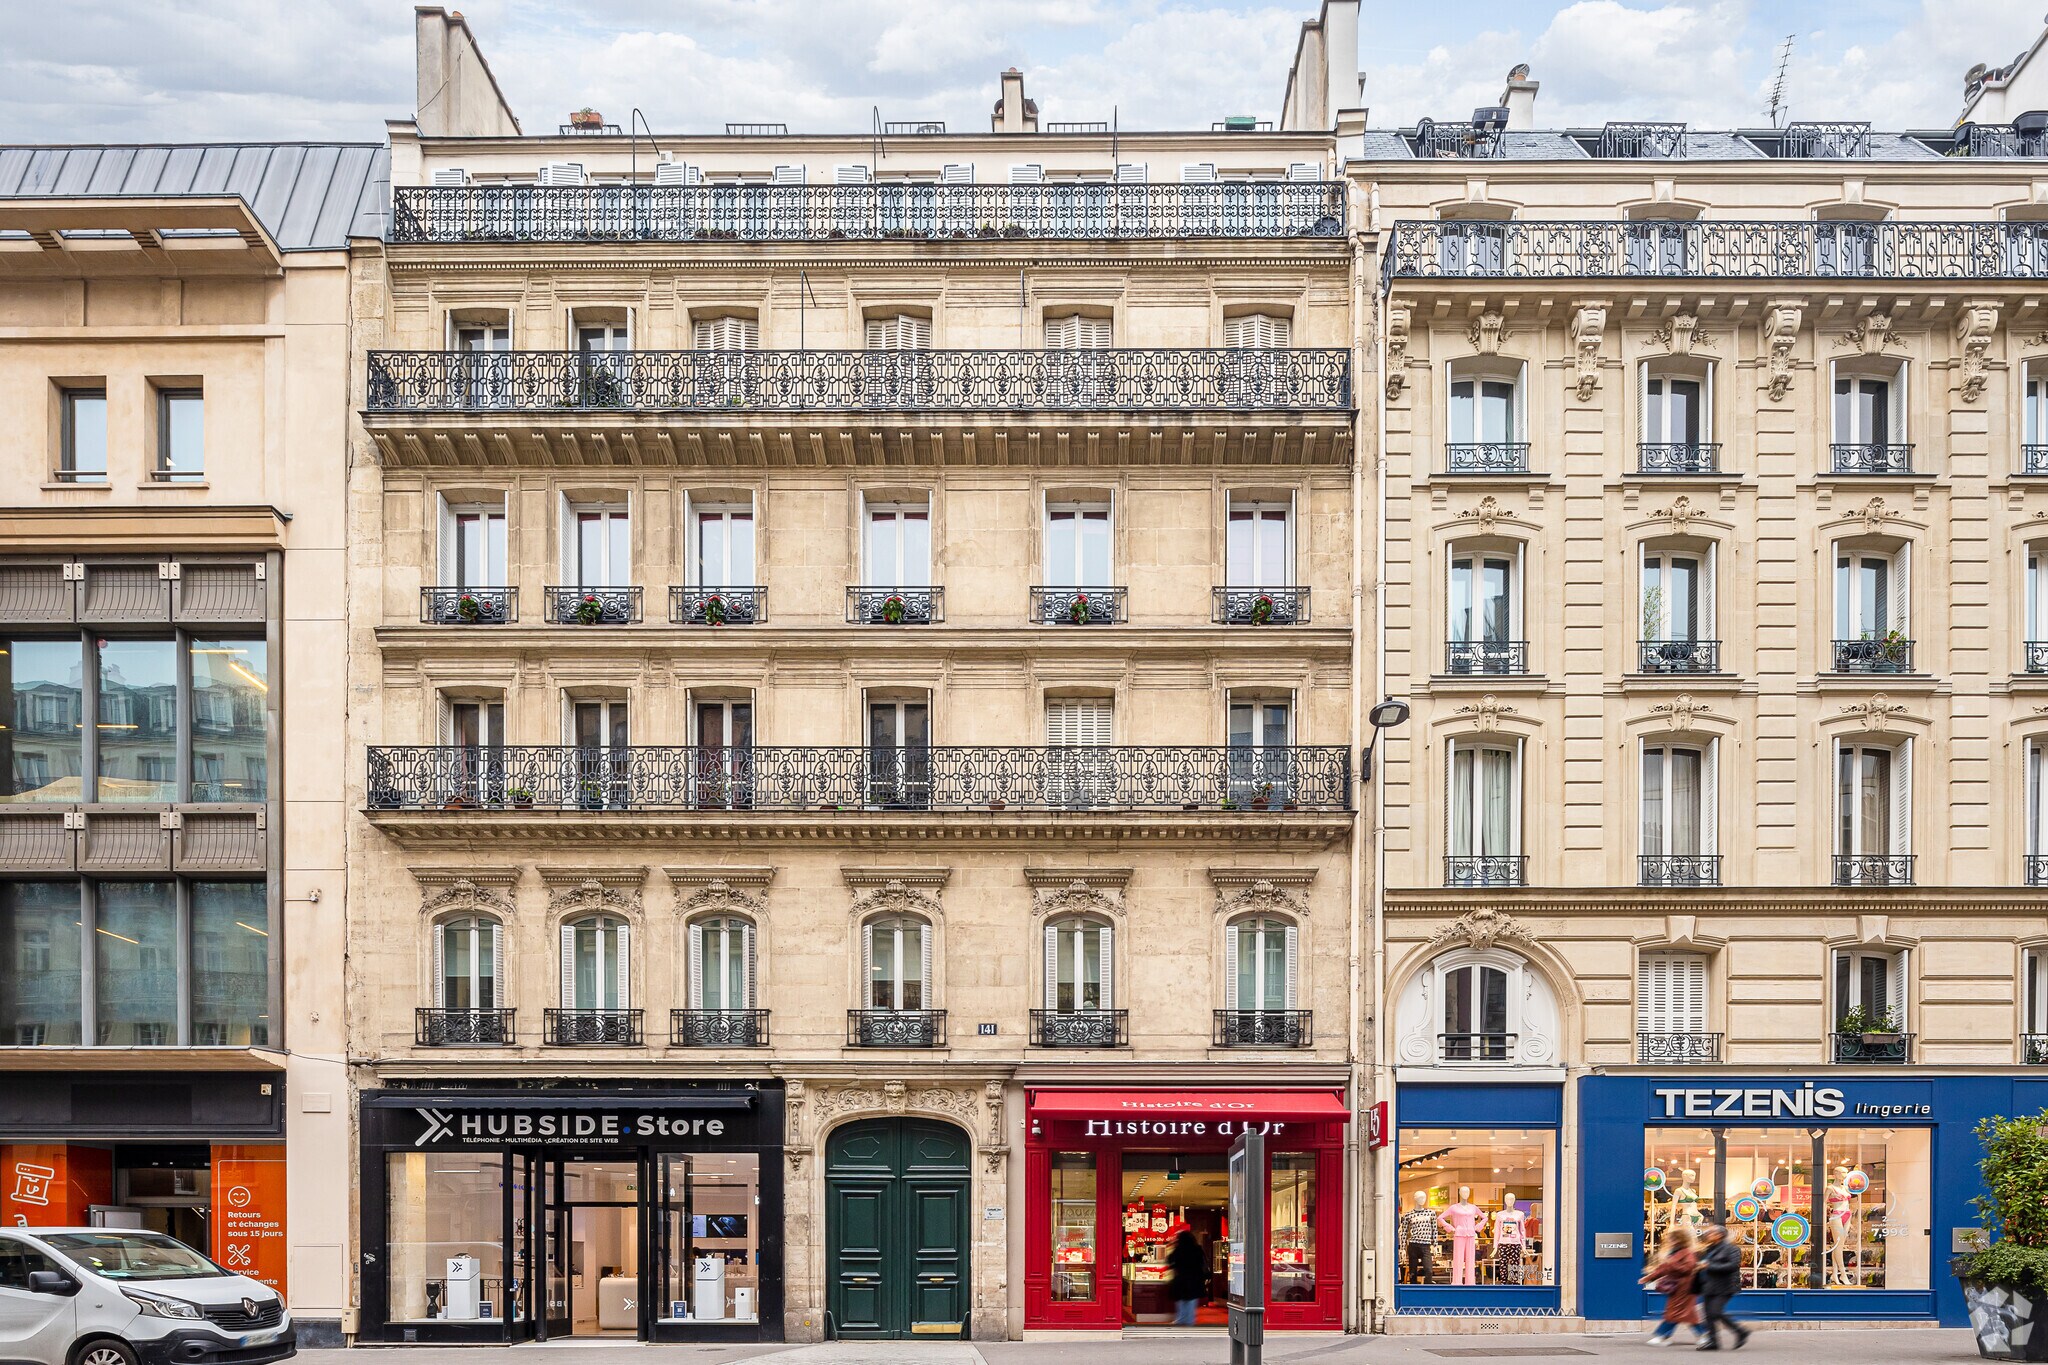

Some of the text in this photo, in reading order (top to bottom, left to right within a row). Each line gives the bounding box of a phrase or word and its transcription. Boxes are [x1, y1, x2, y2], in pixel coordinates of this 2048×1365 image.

[980, 1024, 995, 1035] 141
[1121, 1101, 1203, 1109] Histoire
[1856, 1102, 1931, 1117] lingerie
[261, 1230, 283, 1238] jours
